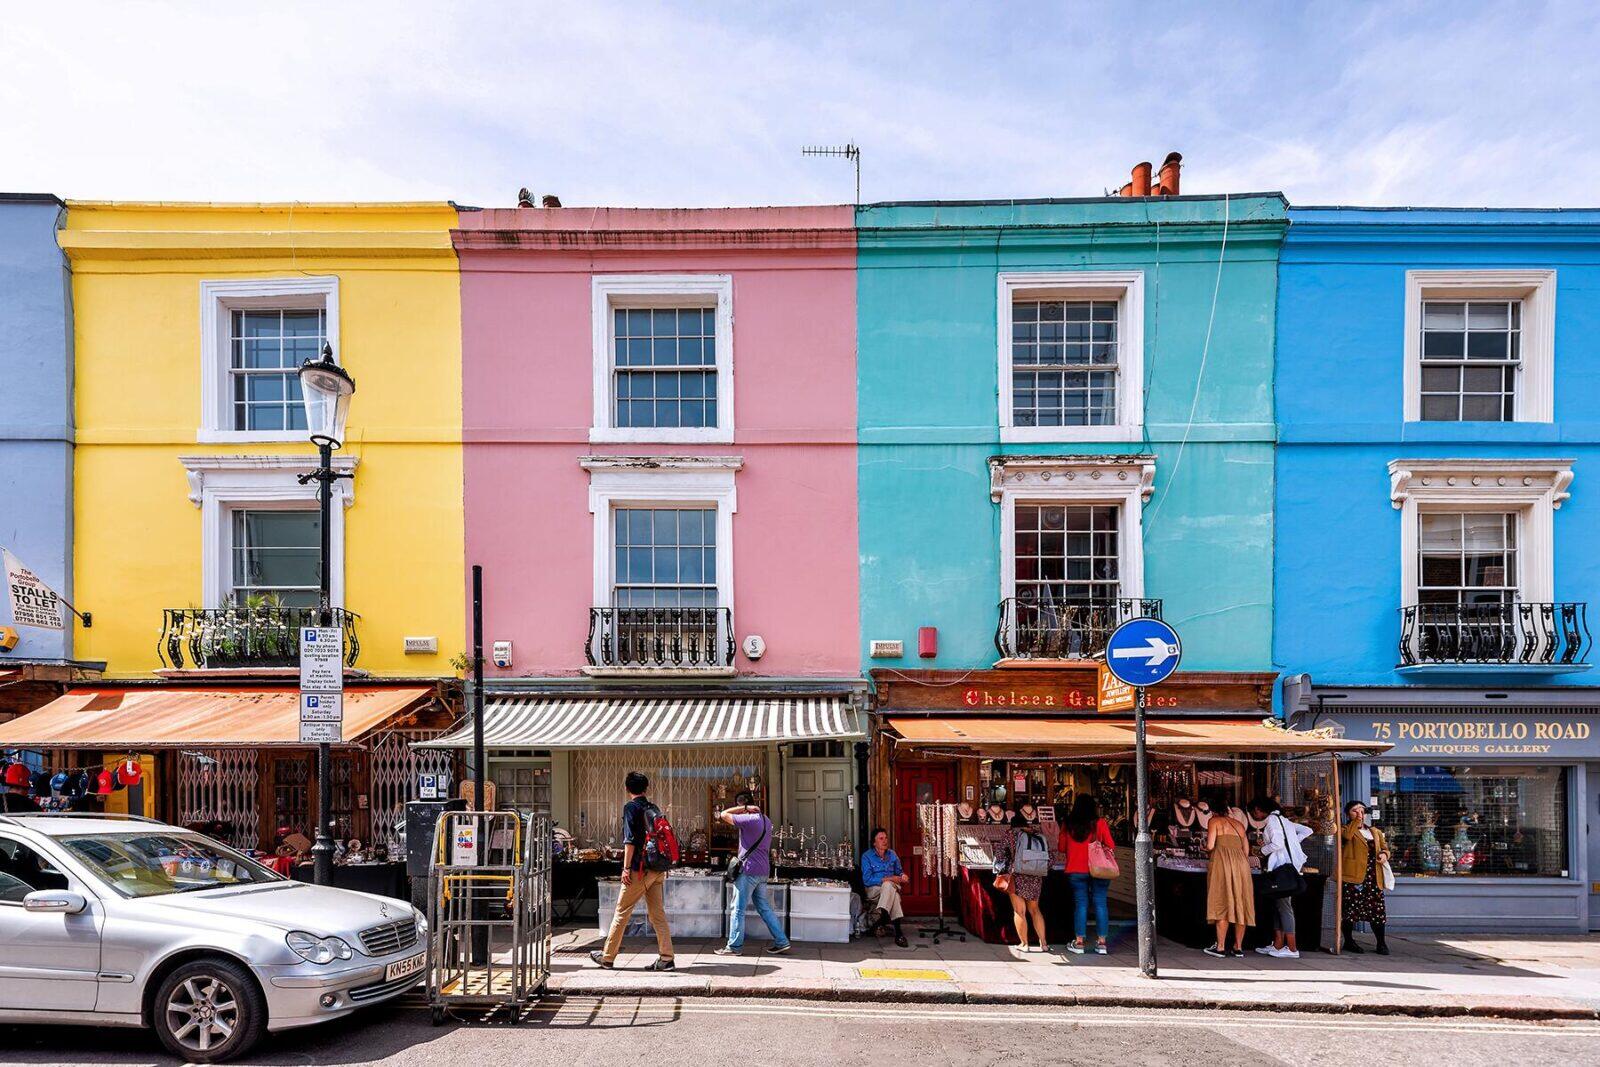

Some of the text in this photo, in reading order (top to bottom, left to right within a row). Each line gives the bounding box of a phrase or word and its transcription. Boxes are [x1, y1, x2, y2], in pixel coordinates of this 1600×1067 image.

[18, 579, 36, 588] Group
[12, 585, 57, 600] STALLS
[14, 594, 56, 608] TO LET
[966, 690, 1054, 706] Chelsea
[1372, 722, 1590, 739] 75 PORTOBELLO ROAD
[1410, 745, 1551, 753] ANTIQUES GALLERY
